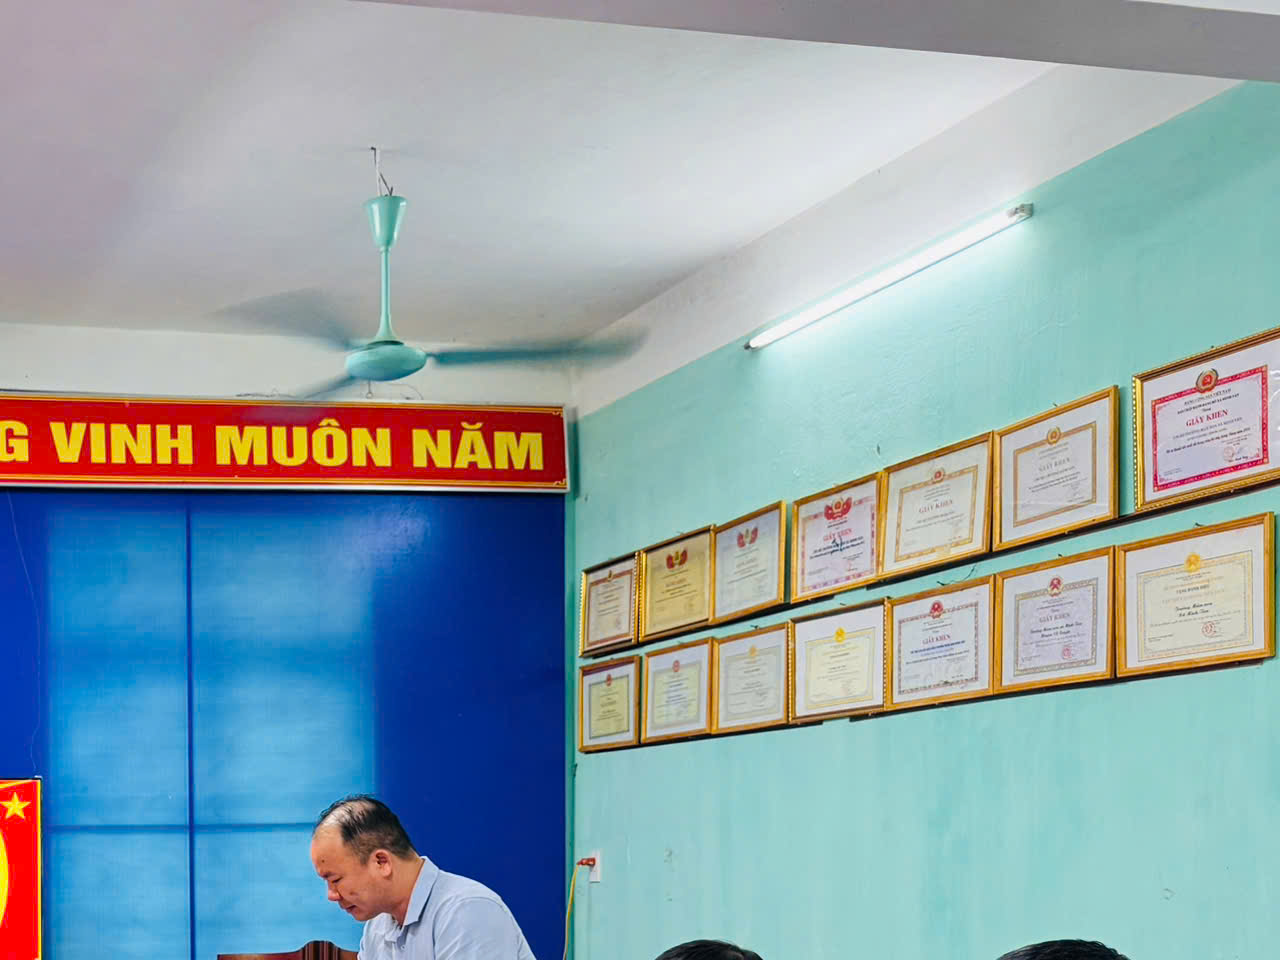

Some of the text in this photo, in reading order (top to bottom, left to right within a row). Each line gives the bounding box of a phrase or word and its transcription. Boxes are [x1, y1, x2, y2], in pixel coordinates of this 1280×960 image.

[50, 422, 193, 465] VINH
[216, 418, 392, 467] MUÔN
[413, 421, 543, 470] NĂM
